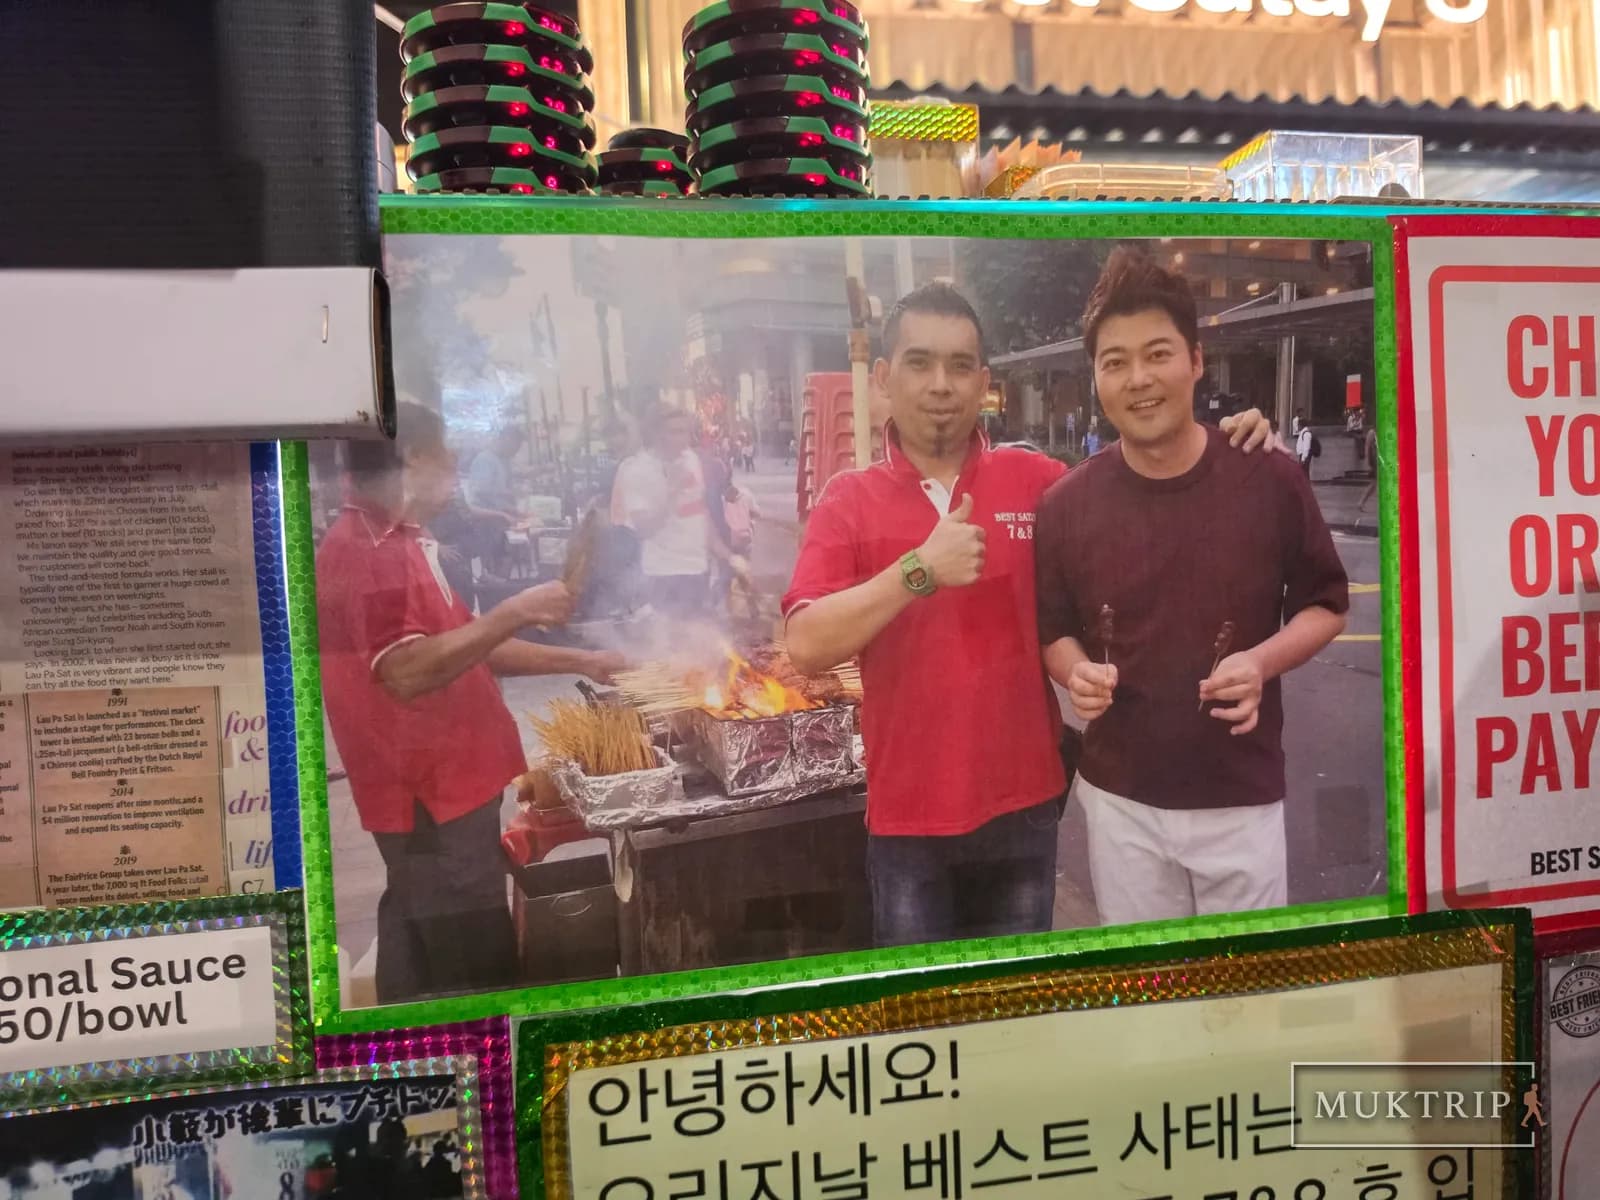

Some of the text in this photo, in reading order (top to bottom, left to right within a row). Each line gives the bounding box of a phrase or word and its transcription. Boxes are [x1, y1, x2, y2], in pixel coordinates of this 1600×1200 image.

[995, 512, 1015, 522] BEST
[110, 787, 134, 797] 2014
[113, 856, 137, 866] 2019
[1531, 848, 1583, 876] BEST
[111, 953, 247, 991] Sauce
[1550, 998, 1574, 1019] BEST
[588, 1040, 960, 1147] 안녕하세요!
[903, 1119, 1098, 1200] 베스트
[1119, 1093, 1302, 1170] 사태는
